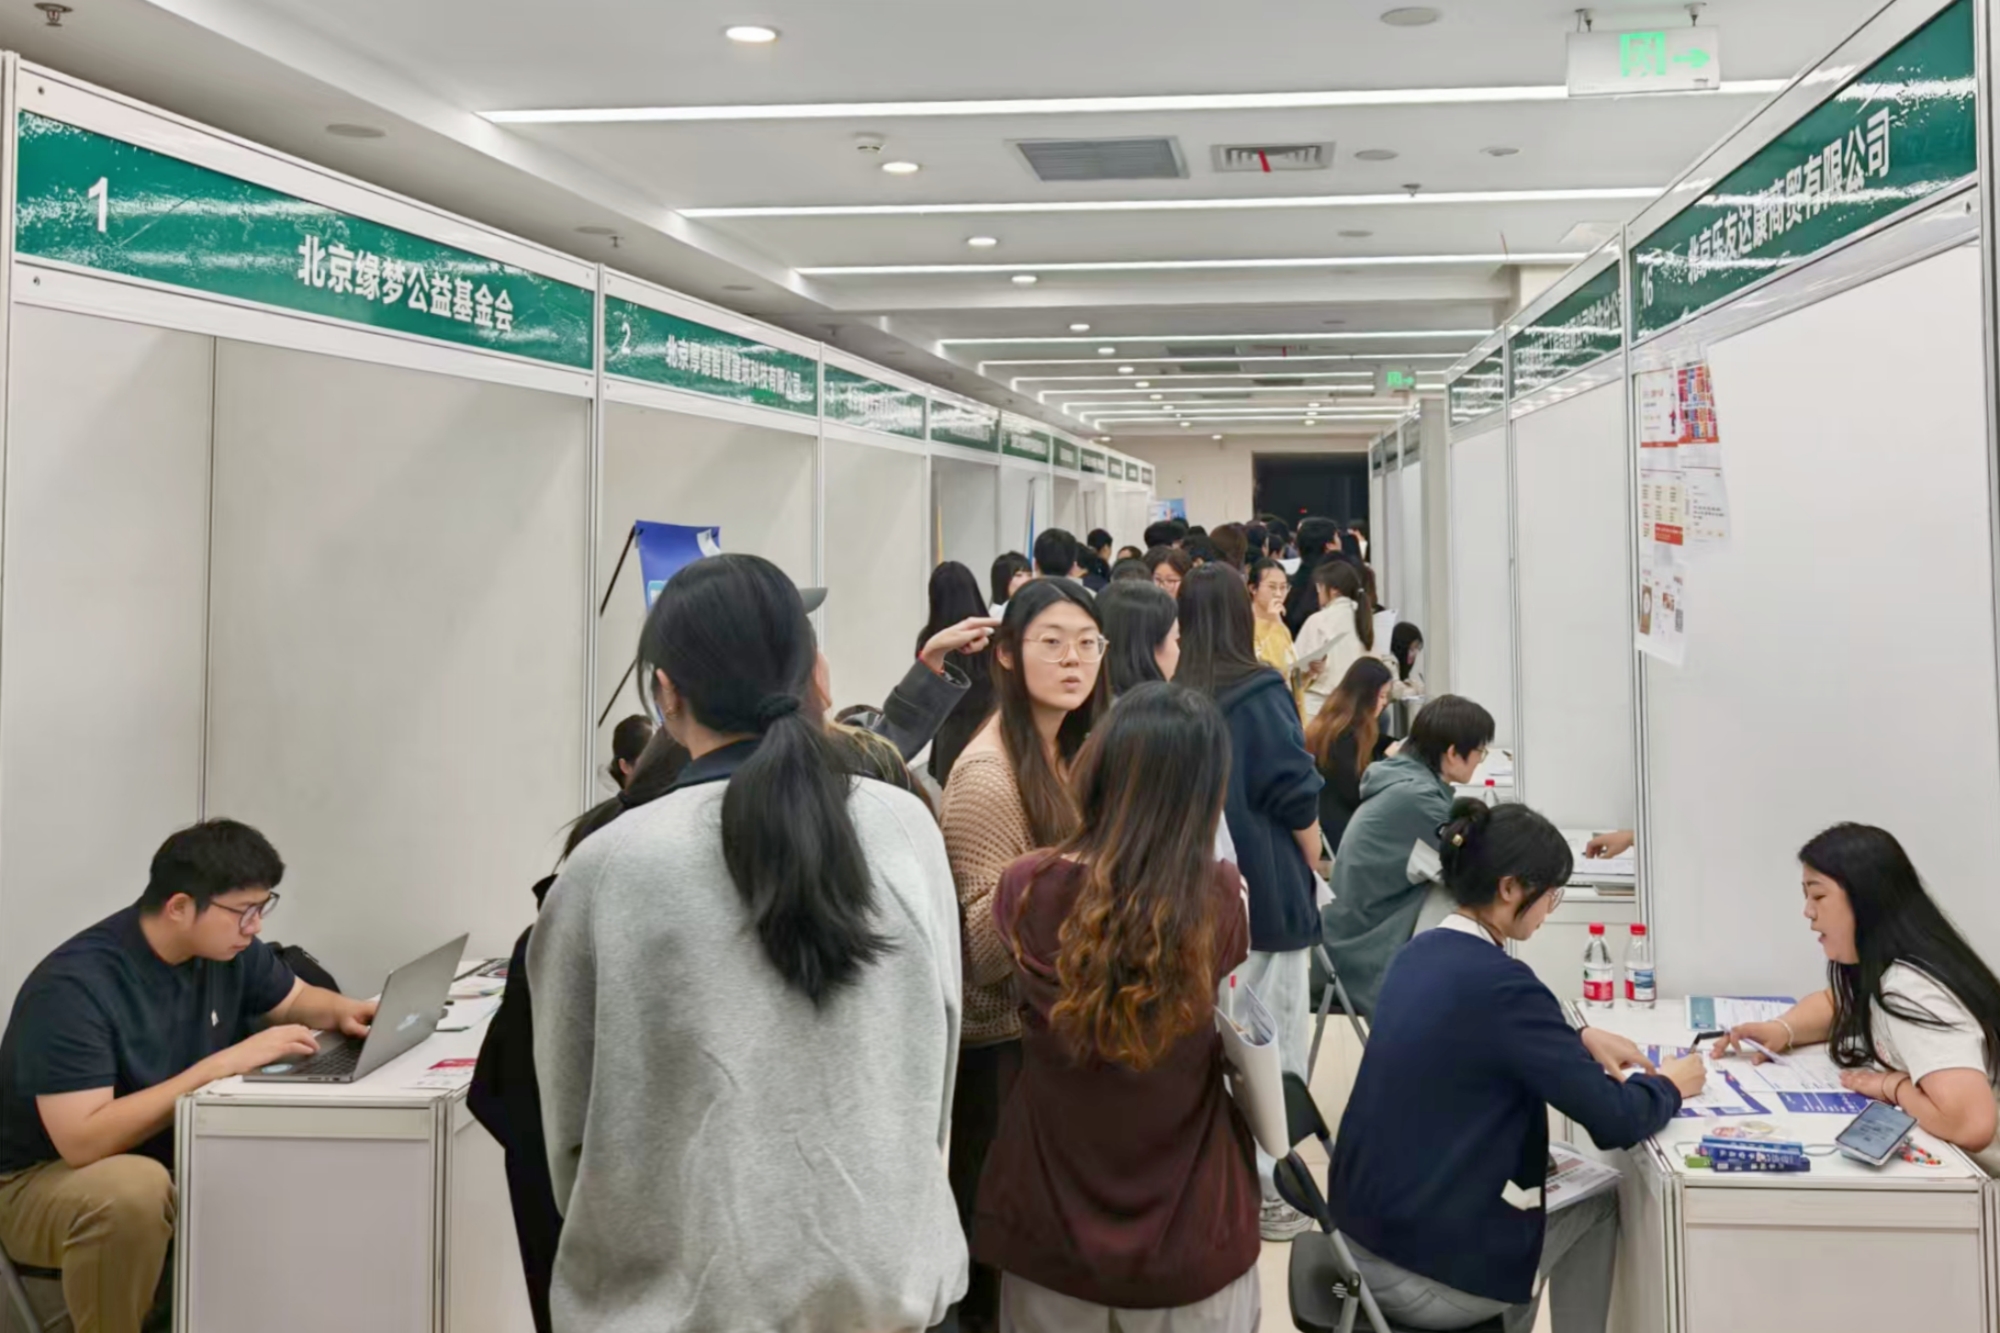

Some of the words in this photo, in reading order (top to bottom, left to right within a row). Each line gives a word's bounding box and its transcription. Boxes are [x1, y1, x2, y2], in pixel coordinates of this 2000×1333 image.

[88, 176, 108, 233] 1
[297, 234, 514, 332] 北京缘梦公益基金会
[1641, 264, 1654, 310] 16
[620, 321, 631, 355] 2
